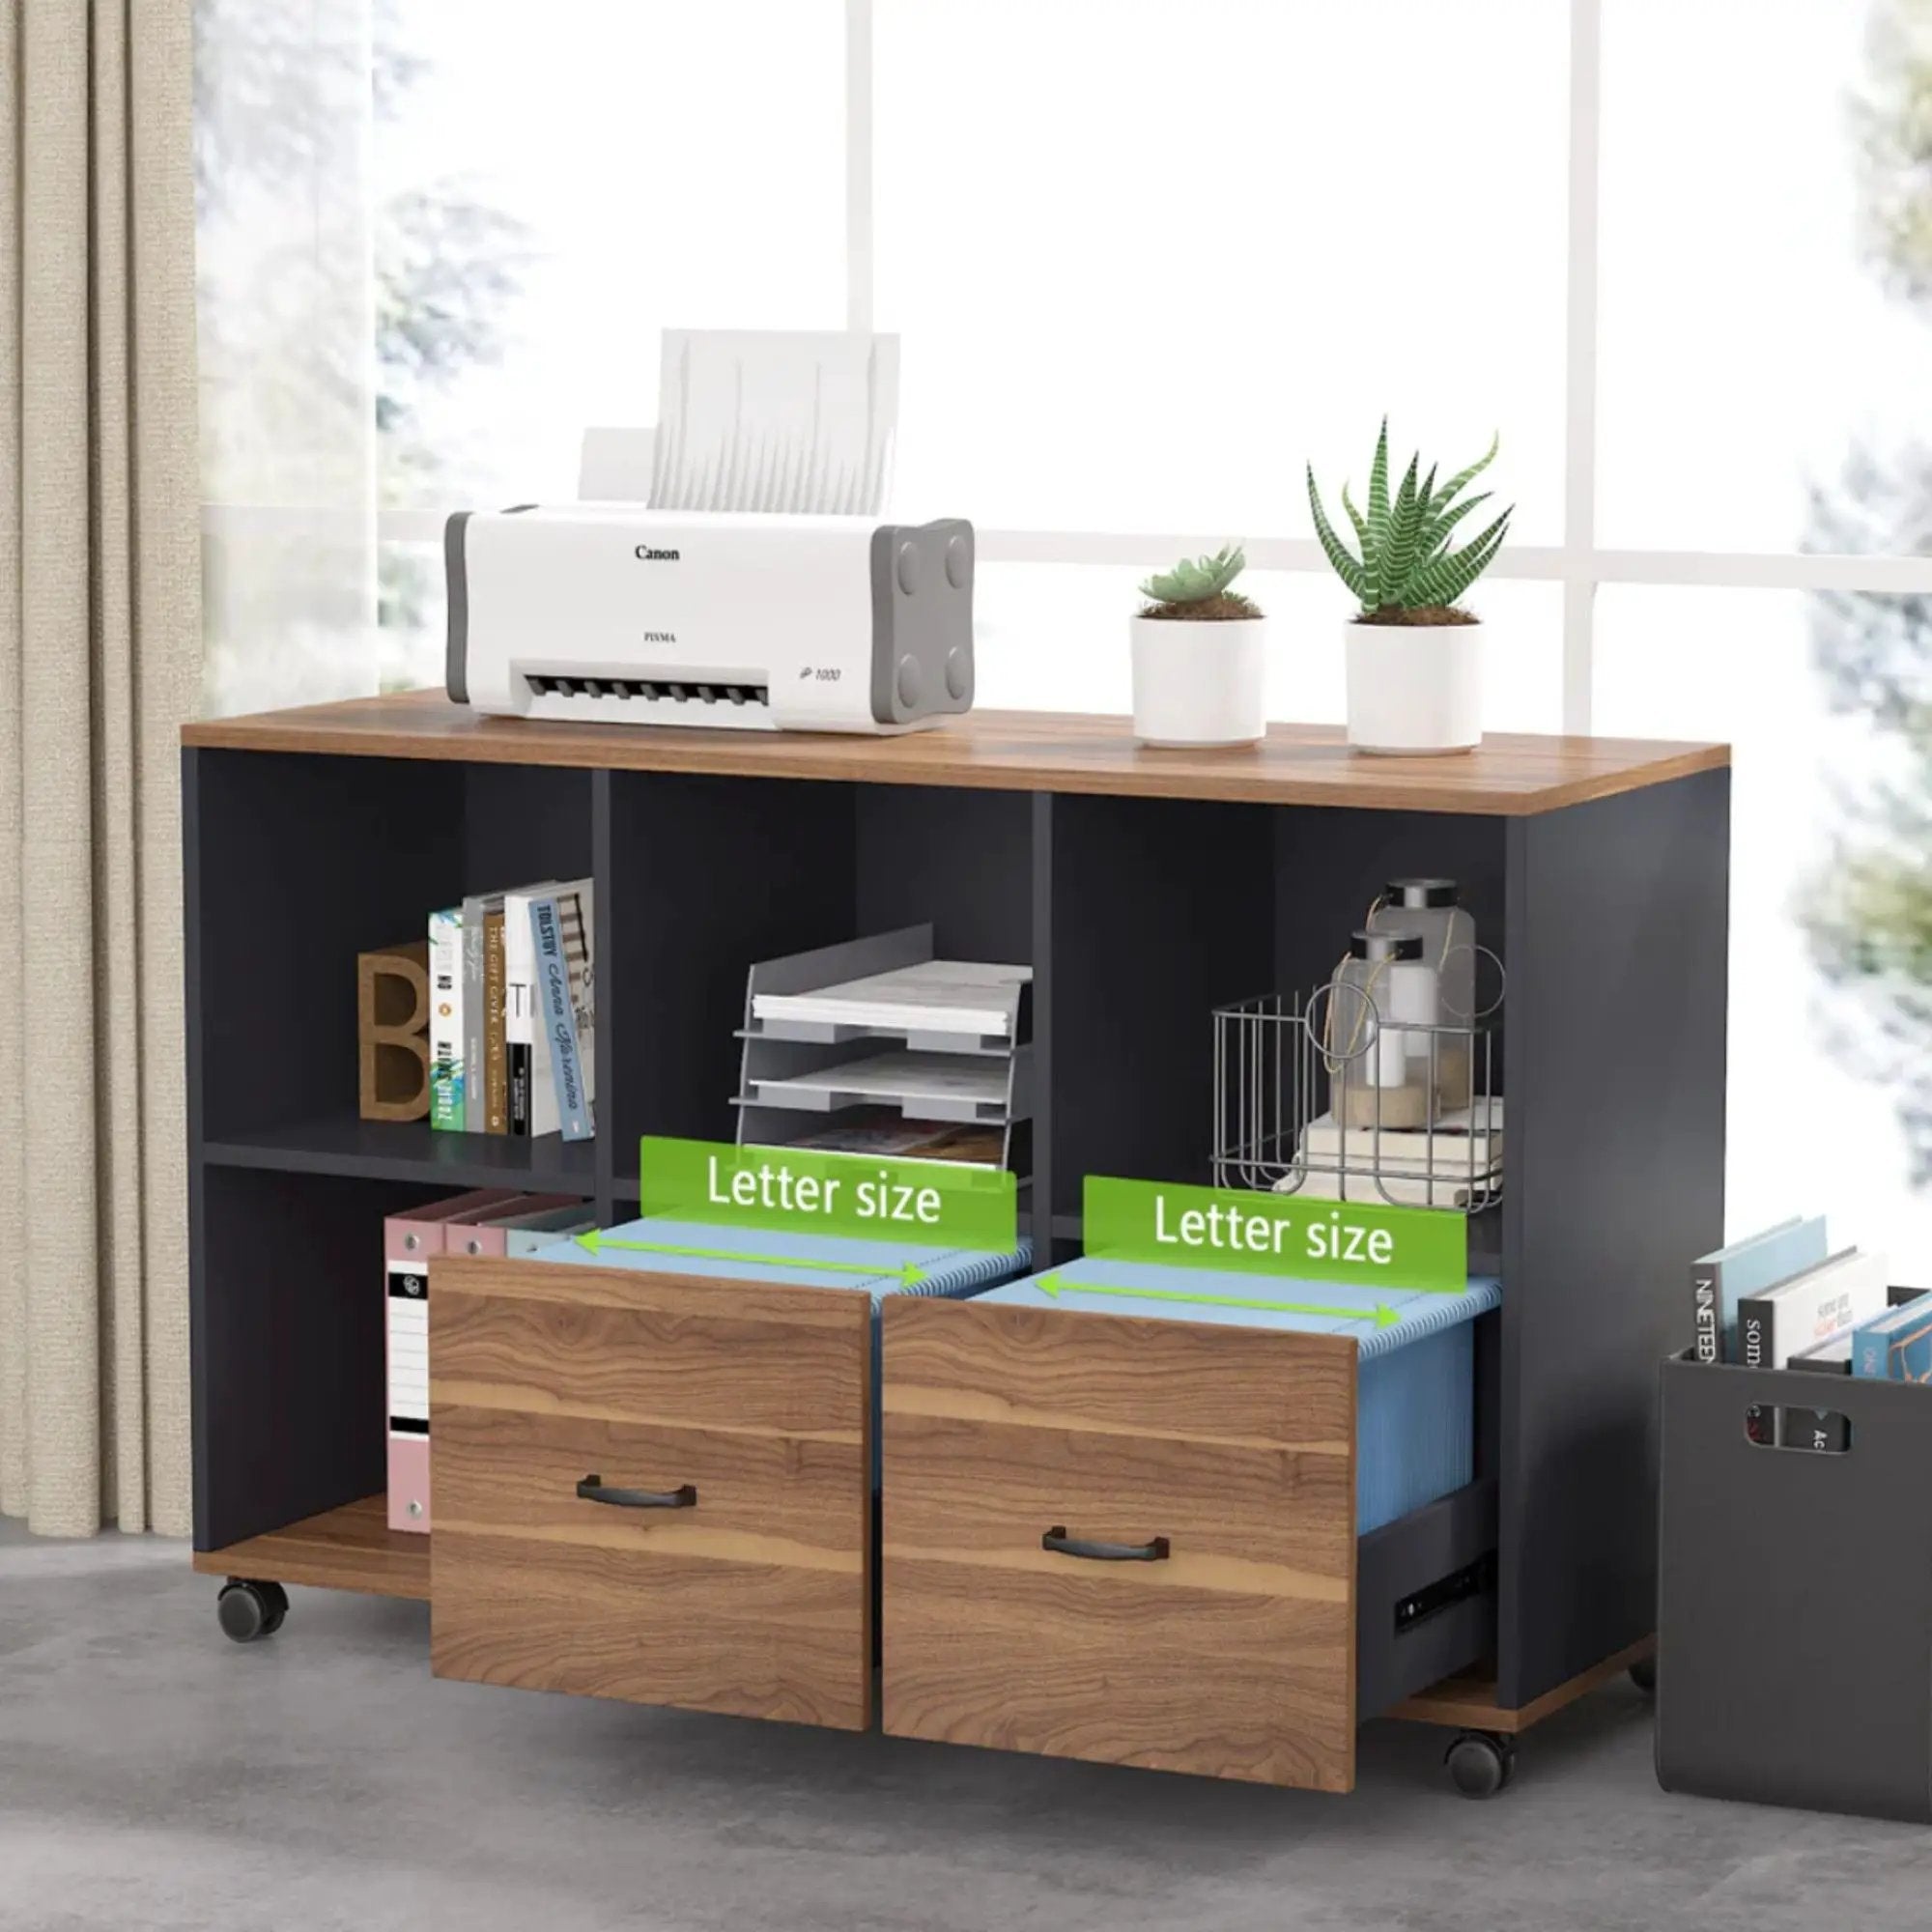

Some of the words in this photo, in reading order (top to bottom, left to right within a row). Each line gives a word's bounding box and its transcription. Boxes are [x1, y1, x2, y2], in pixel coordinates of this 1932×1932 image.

[635, 544, 680, 561] Canon
[643, 631, 676, 643] PIXMA
[815, 668, 841, 681] 1000
[537, 904, 557, 956] TOLSTOY
